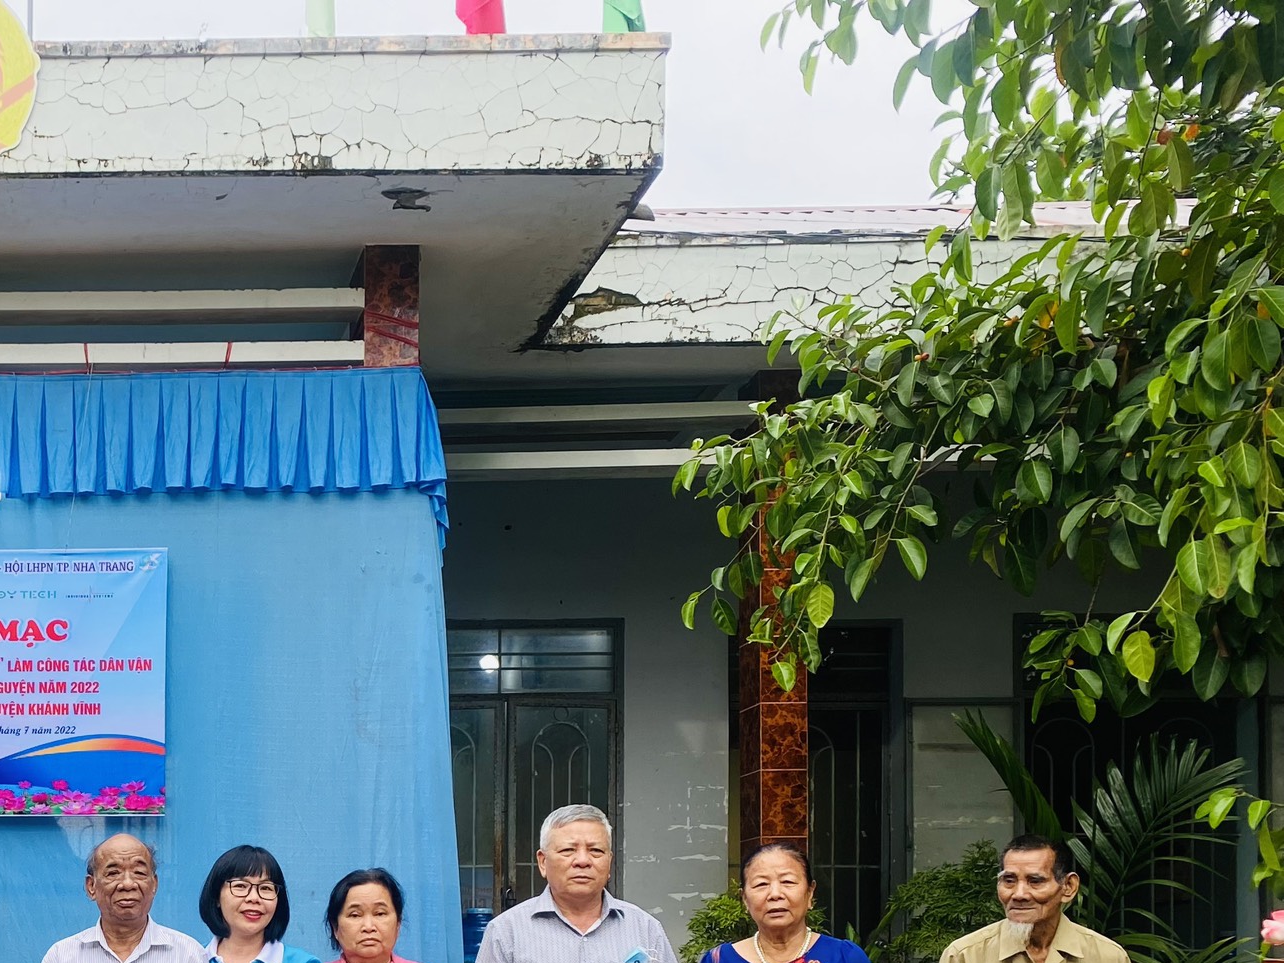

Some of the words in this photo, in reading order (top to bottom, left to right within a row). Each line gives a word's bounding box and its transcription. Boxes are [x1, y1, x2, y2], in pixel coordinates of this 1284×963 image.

[4, 559, 23, 574] HỘI
[27, 562, 53, 573] LHPN
[73, 561, 96, 572] NHA
[99, 561, 134, 572] TRANG
[20, 590, 57, 599] TECH
[7, 657, 33, 672] LÀM
[36, 657, 70, 672] CÔNG
[73, 656, 96, 672] TÁC
[99, 657, 124, 672] DÂN
[128, 657, 152, 674] VẬN
[39, 679, 67, 694] NĂM
[70, 681, 100, 694] 2022
[28, 701, 69, 716] KHÁNH
[73, 701, 101, 715] VĨNH
[24, 726, 29, 735] 7
[31, 726, 52, 735] năm
[54, 725, 76, 735] 2022
